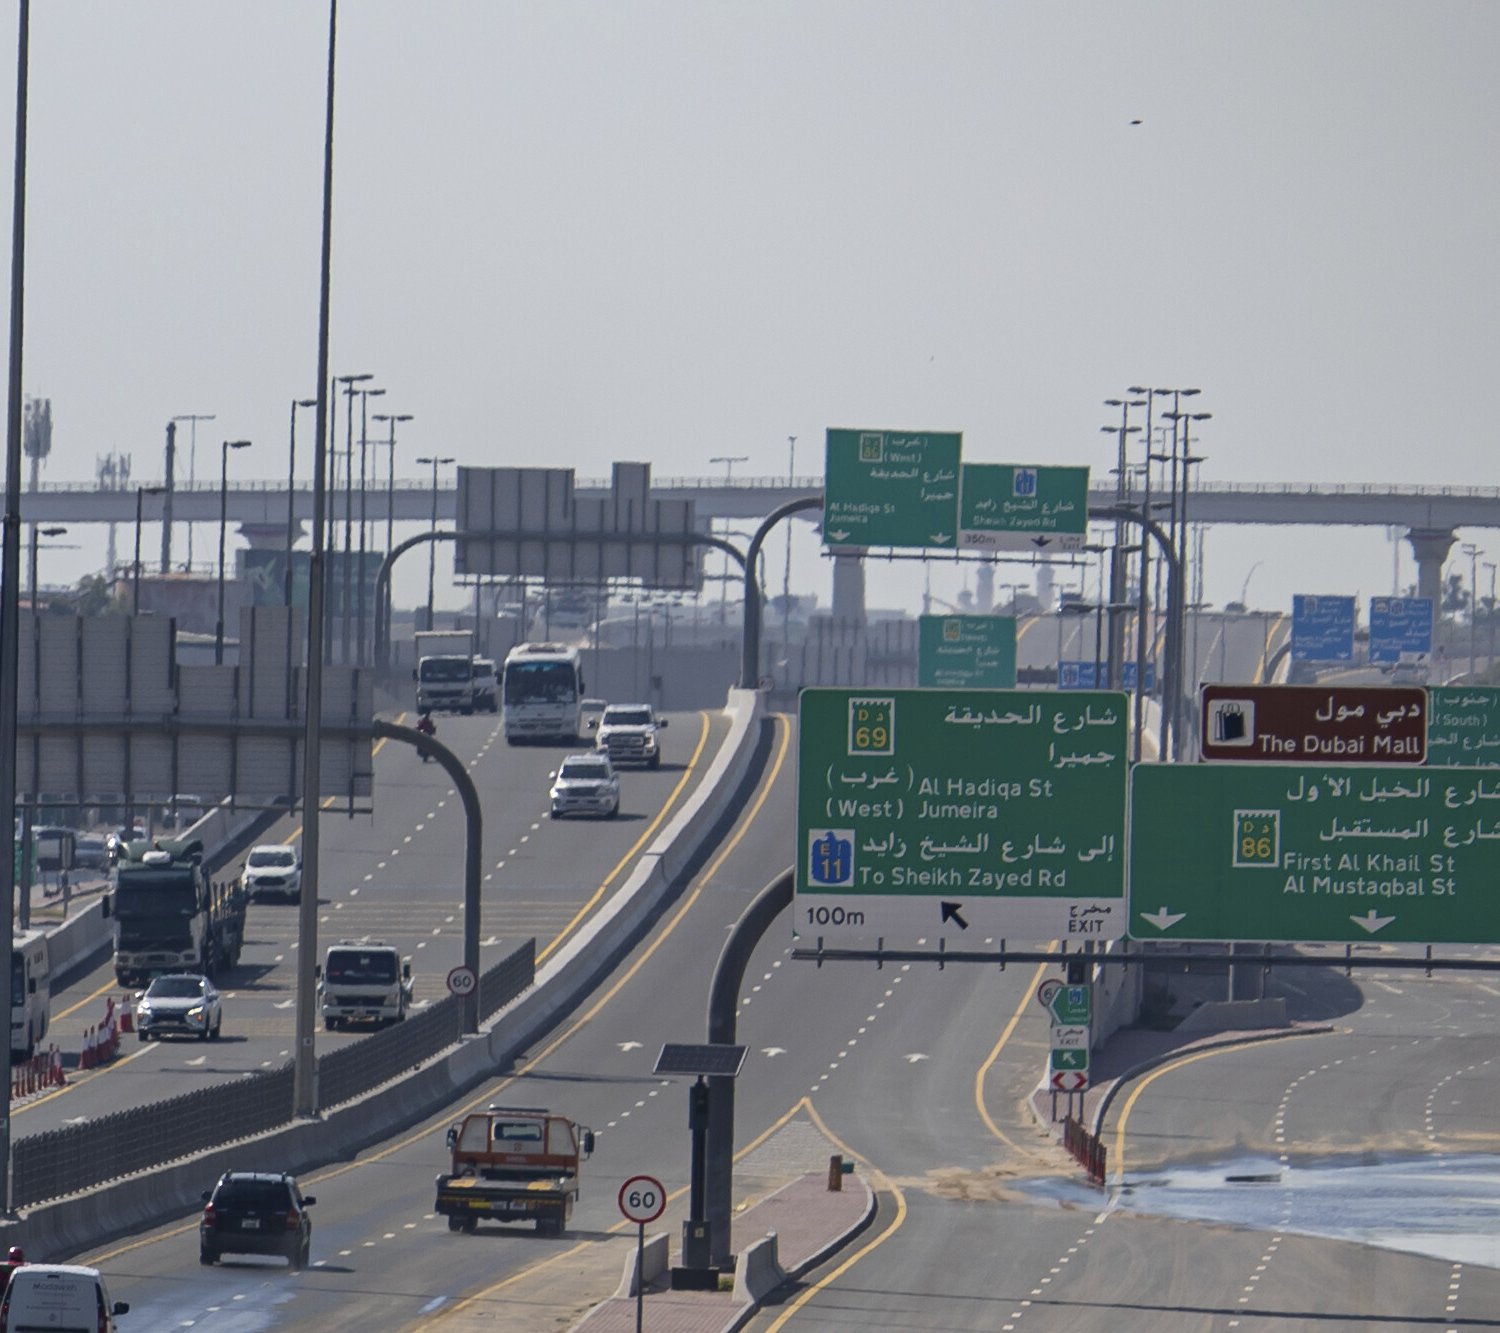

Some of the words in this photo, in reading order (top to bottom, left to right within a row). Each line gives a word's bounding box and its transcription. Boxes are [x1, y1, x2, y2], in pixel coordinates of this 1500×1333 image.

[945, 705, 1041, 730] الحديقة
[1053, 705, 1118, 734] شارع
[1316, 697, 1364, 722] مول
[1377, 702, 1421, 728] دبي
[1436, 714, 1488, 727] (South)
[855, 728, 887, 747] 69
[1258, 734, 1296, 753] The
[1304, 735, 1365, 754] Dubai
[1373, 735, 1420, 754] Mall
[1049, 743, 1116, 768] جميرا
[918, 778, 940, 796] Al
[947, 778, 1022, 800] Hadiqa
[1029, 778, 1053, 797] St
[1360, 777, 1430, 802] الخيل
[826, 798, 904, 819] (West)
[918, 801, 998, 819] Jumeira
[1319, 817, 1429, 841] المستقبل
[862, 831, 907, 859] زايد
[919, 833, 989, 861] الشيخ
[1001, 834, 1066, 862] شارع
[1078, 835, 1115, 862] إلى
[1242, 837, 1271, 859] 86
[821, 858, 843, 879] 11
[1283, 853, 1332, 872] First
[1338, 854, 1360, 872] Al
[1367, 854, 1420, 872] Khail
[1430, 854, 1456, 873] St
[860, 867, 885, 885] To
[892, 867, 963, 885] Sheikh
[968, 868, 1033, 890] Zayed
[1039, 869, 1066, 887] Rd
[1283, 875, 1305, 893] Al
[1313, 876, 1425, 898] Mustaqbal
[1431, 877, 1456, 896] St
[807, 907, 865, 925] 100m
[1069, 904, 1112, 918] مخرج
[1069, 920, 1104, 933] EXIT
[452, 976, 471, 988] 60
[629, 1192, 655, 1208] 60
